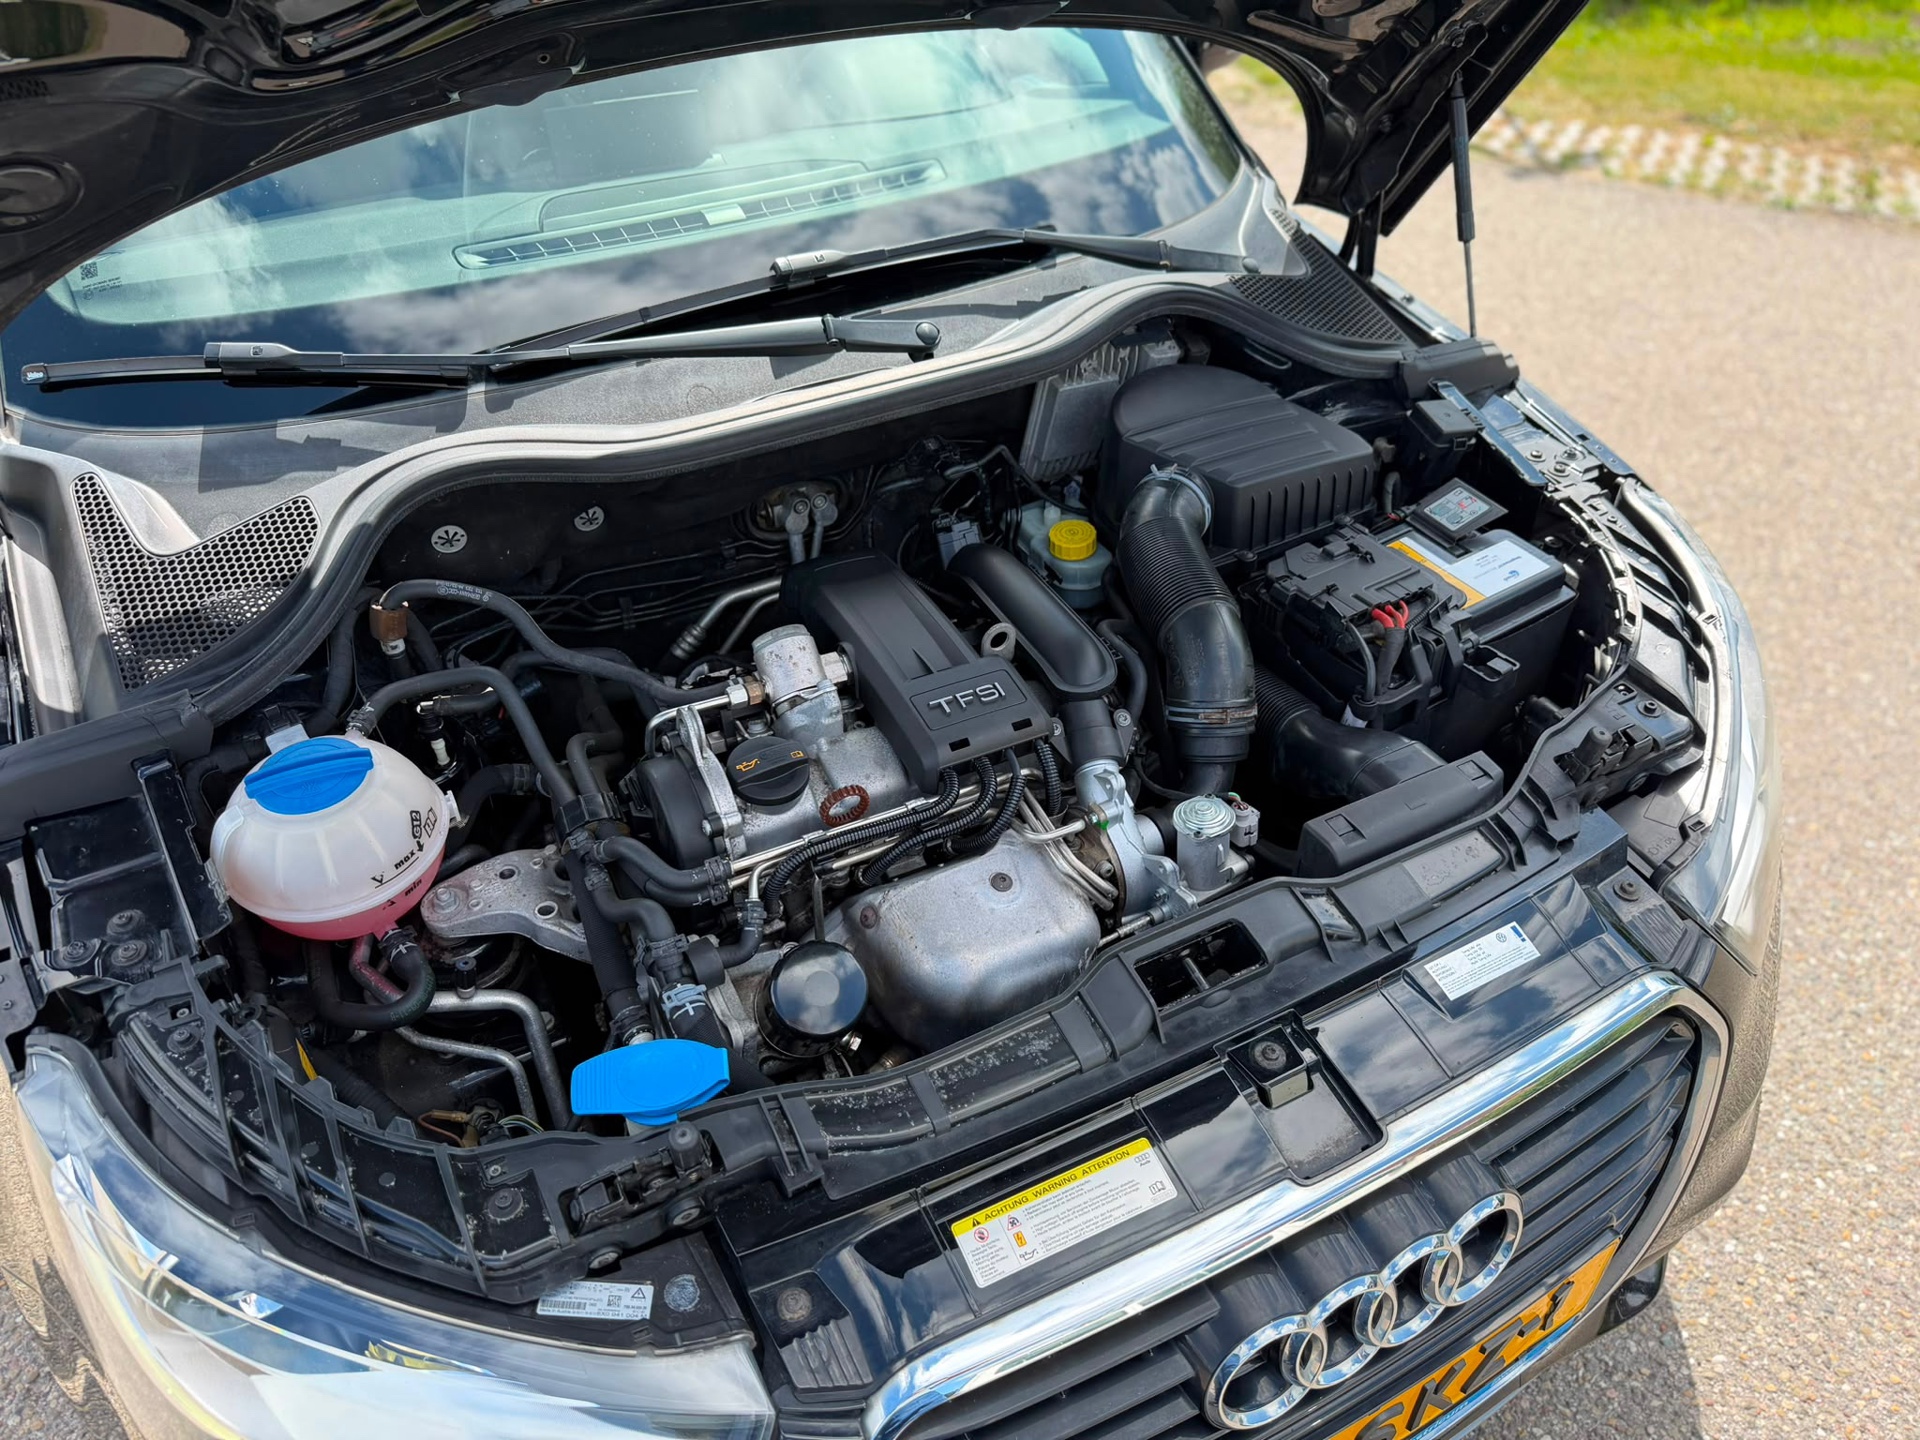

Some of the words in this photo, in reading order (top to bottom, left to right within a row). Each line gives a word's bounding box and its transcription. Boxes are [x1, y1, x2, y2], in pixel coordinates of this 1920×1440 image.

[928, 682, 1006, 714] TFSI
[411, 810, 422, 839] G12
[394, 849, 416, 870] max
[405, 879, 422, 897] min
[984, 1195, 1029, 1221] ACHTUNG
[1032, 1174, 1078, 1199] WARNING
[1082, 1150, 1130, 1176] ATTENTION
